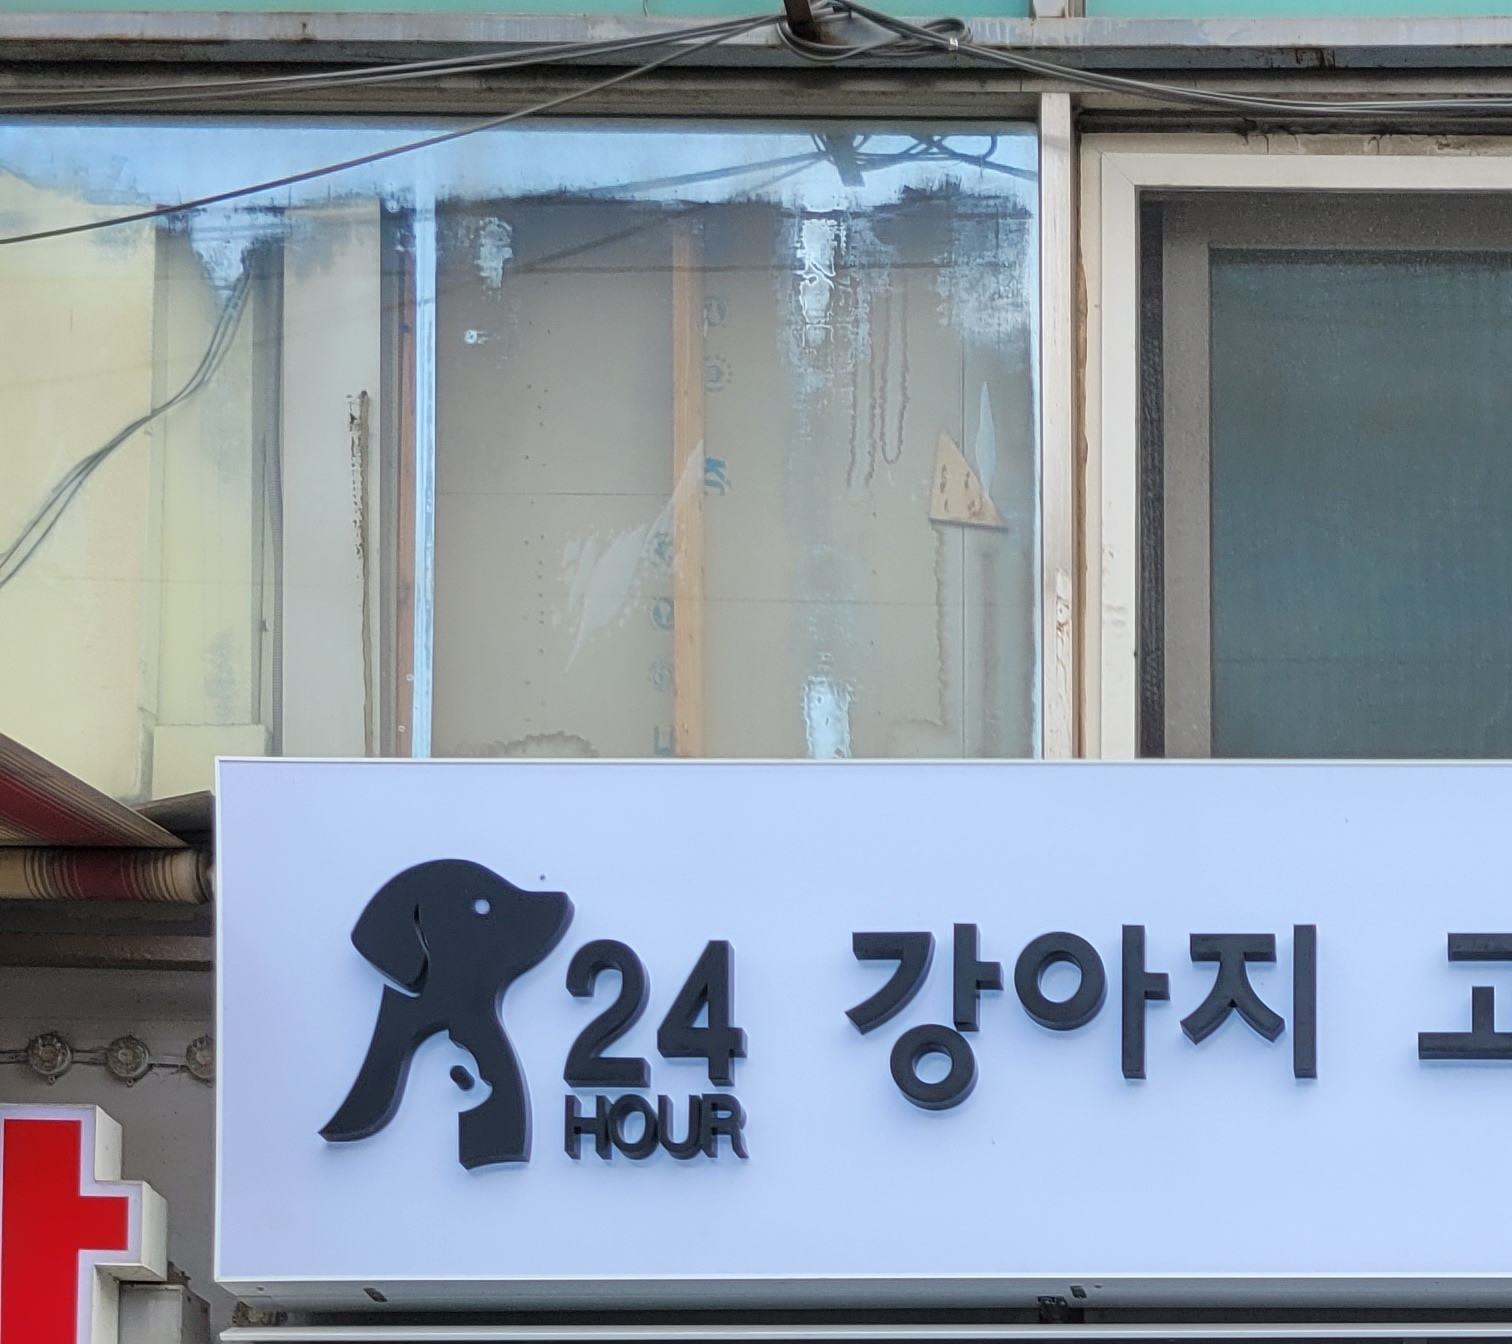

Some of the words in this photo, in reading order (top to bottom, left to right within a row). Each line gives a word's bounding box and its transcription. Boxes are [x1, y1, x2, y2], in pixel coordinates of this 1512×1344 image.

[565, 939, 747, 1087] 24
[845, 923, 1317, 1111] 강아지
[565, 1093, 750, 1161] HOUR
